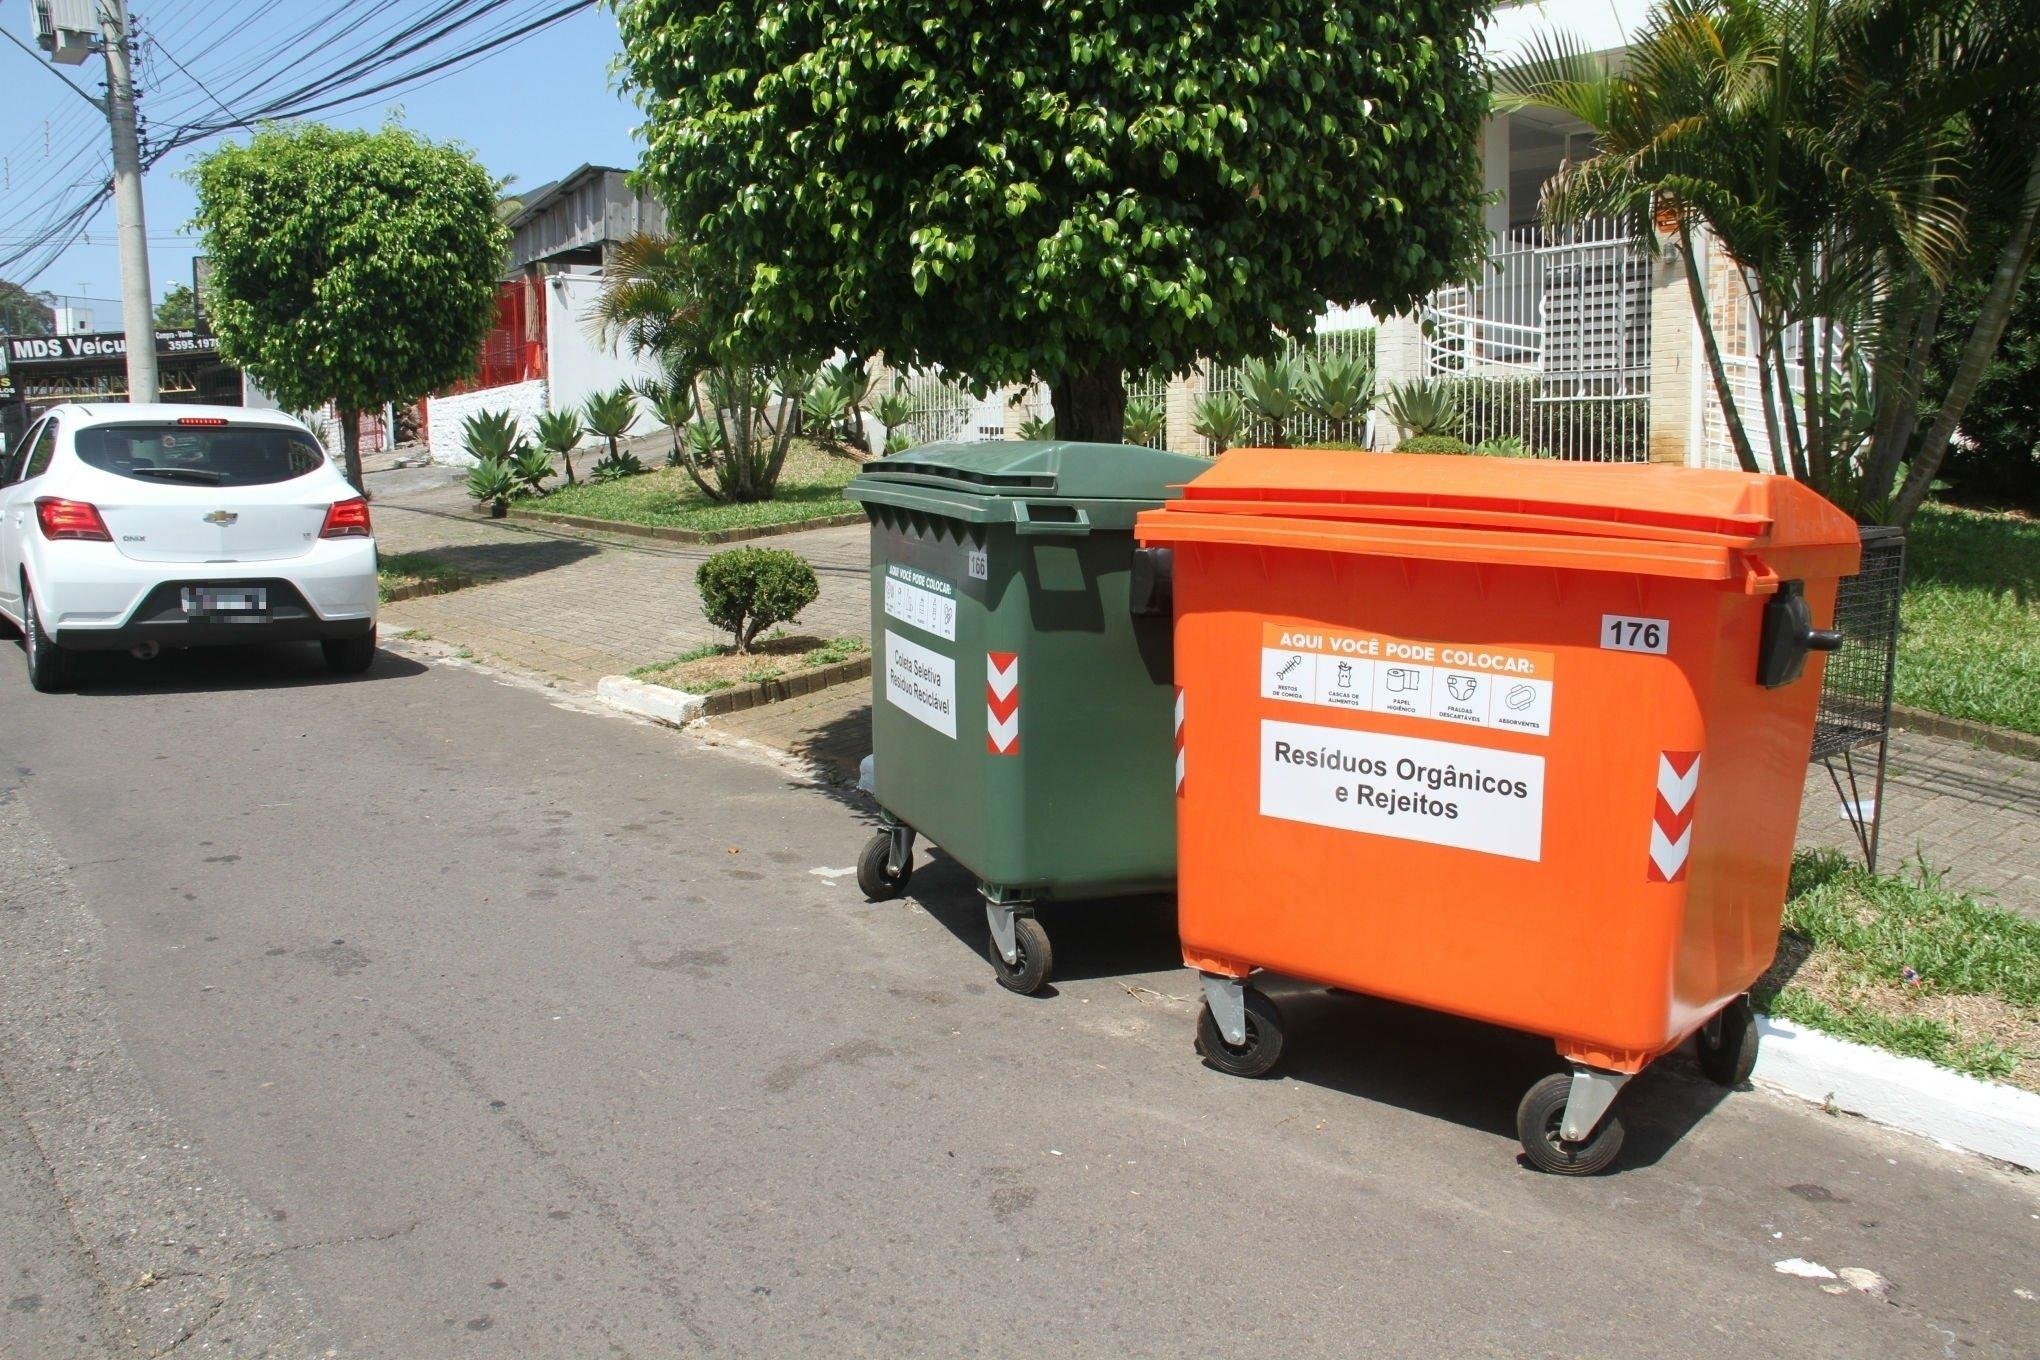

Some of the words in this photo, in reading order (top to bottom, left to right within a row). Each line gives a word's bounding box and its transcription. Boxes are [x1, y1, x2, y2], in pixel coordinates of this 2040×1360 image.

[13, 339, 63, 358] MDS
[972, 556, 985, 576] 166
[889, 565, 899, 577] AQUI
[912, 572, 925, 586] PODE
[926, 578, 951, 594] COLOCAR:
[1609, 620, 1661, 649] 176
[1280, 632, 1323, 650] AQUI
[1329, 637, 1380, 656] VOCÊ
[1385, 644, 1435, 662] PODE
[1441, 649, 1535, 674] COLOCAR:
[894, 649, 912, 672] Coleta
[914, 659, 941, 686] Seletiva
[914, 682, 949, 715] Reciclável
[1328, 698, 1359, 706] ALIMENTOS
[1387, 705, 1416, 713] HIGIÊNICO
[1447, 706, 1473, 714] FRALDAS
[1439, 712, 1480, 723] DESCARTÁVEIS
[1498, 718, 1540, 729] ABSORVENTES
[1274, 741, 1388, 776] Resíduos
[1395, 757, 1529, 799] Orgânicos
[1335, 784, 1348, 803] e
[1357, 784, 1459, 821] Rejeitos
